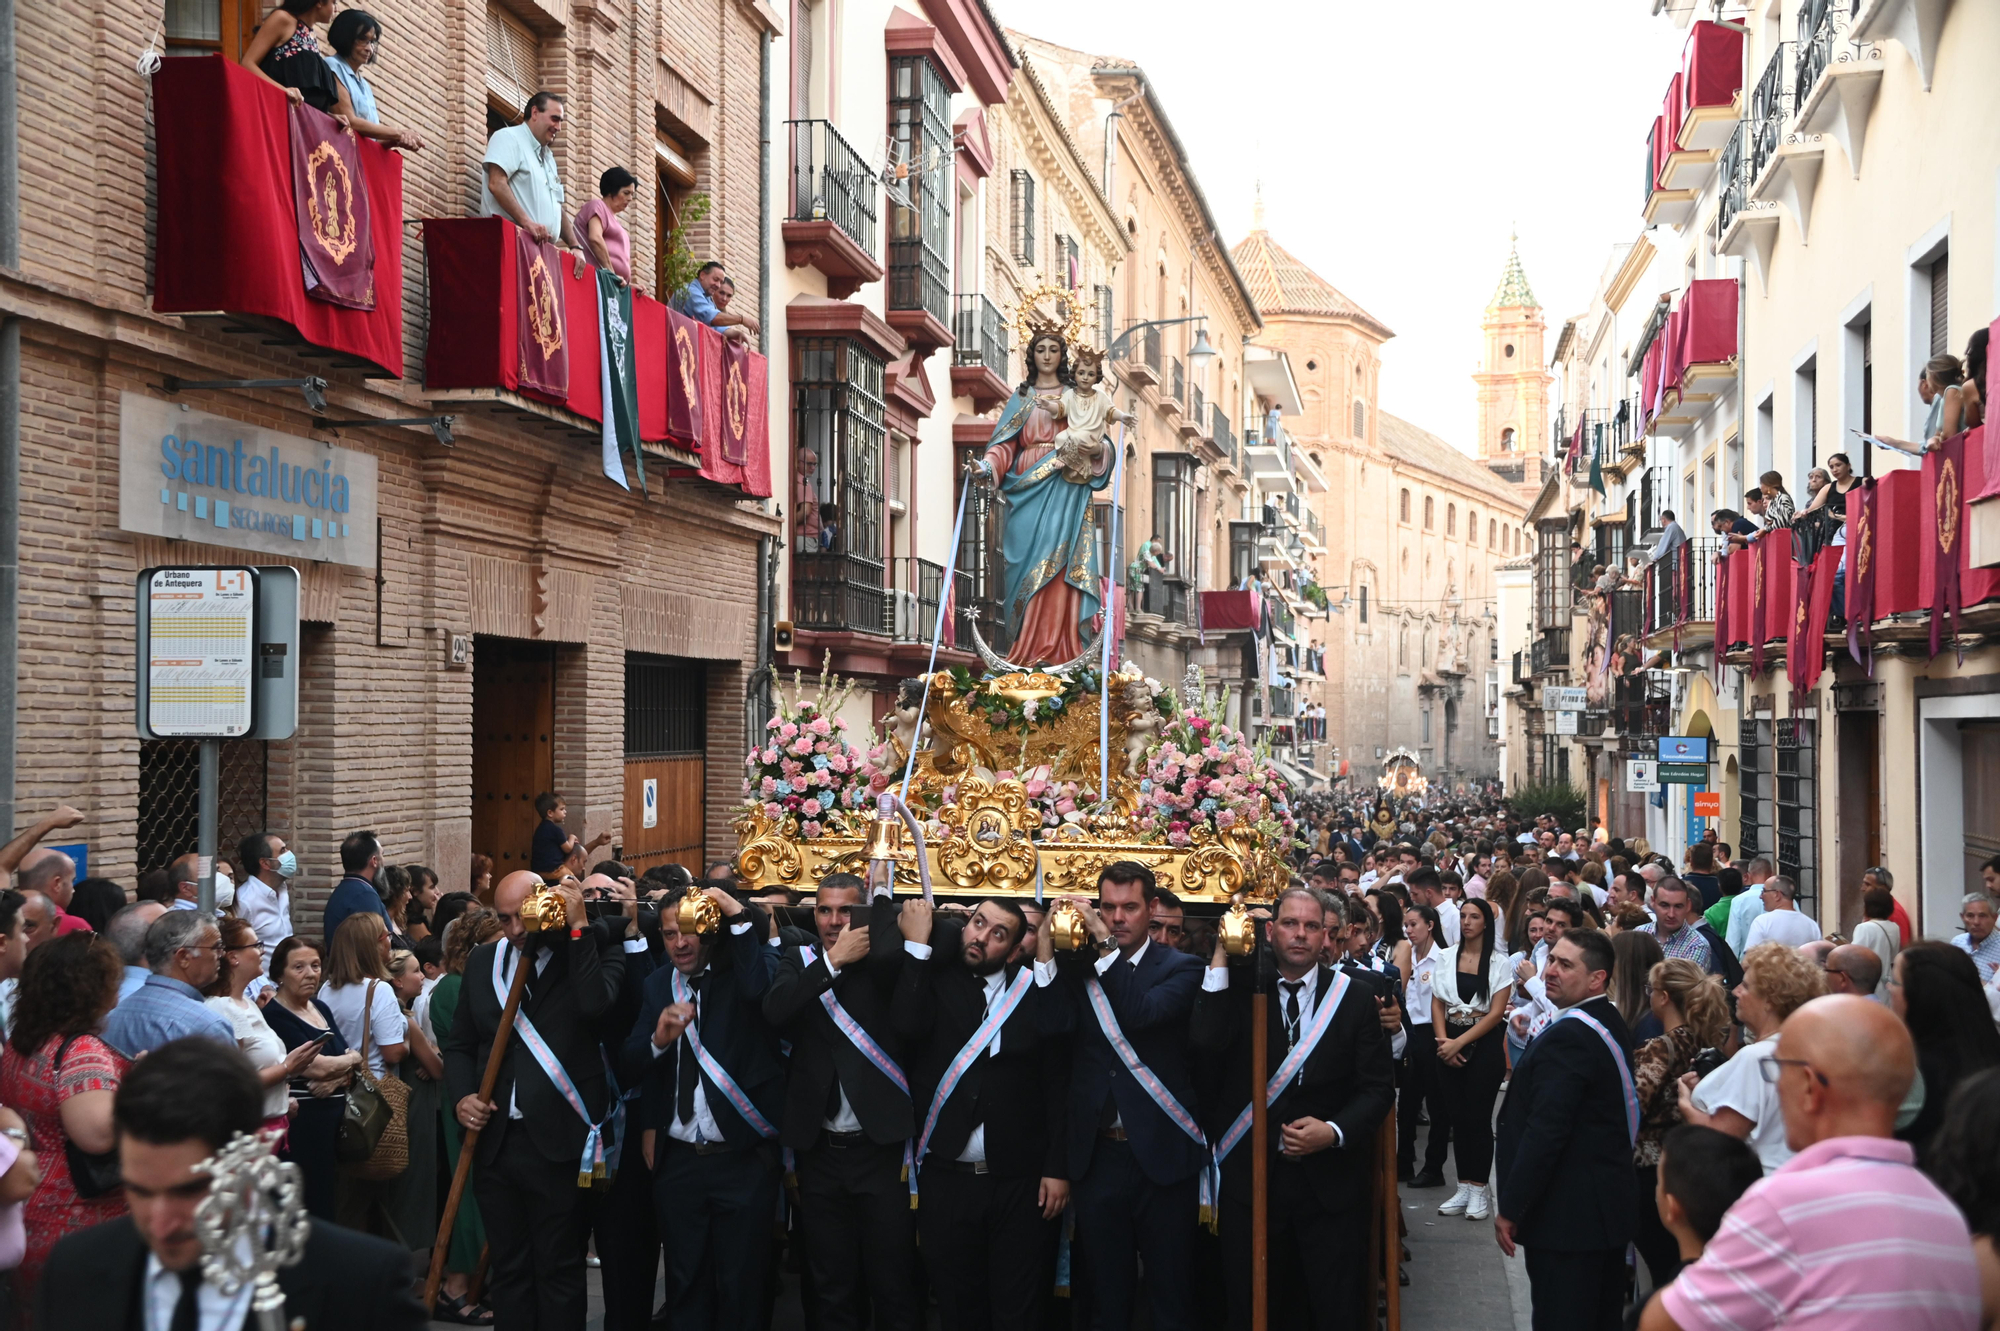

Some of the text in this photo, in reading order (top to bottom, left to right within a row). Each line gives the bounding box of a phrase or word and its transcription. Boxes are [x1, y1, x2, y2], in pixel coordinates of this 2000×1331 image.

[161, 434, 349, 514] santalucía
[164, 570, 190, 579] Urbano
[154, 579, 203, 588] de Antequera
[216, 570, 245, 590] L-1
[1694, 800, 1719, 809] simyo
